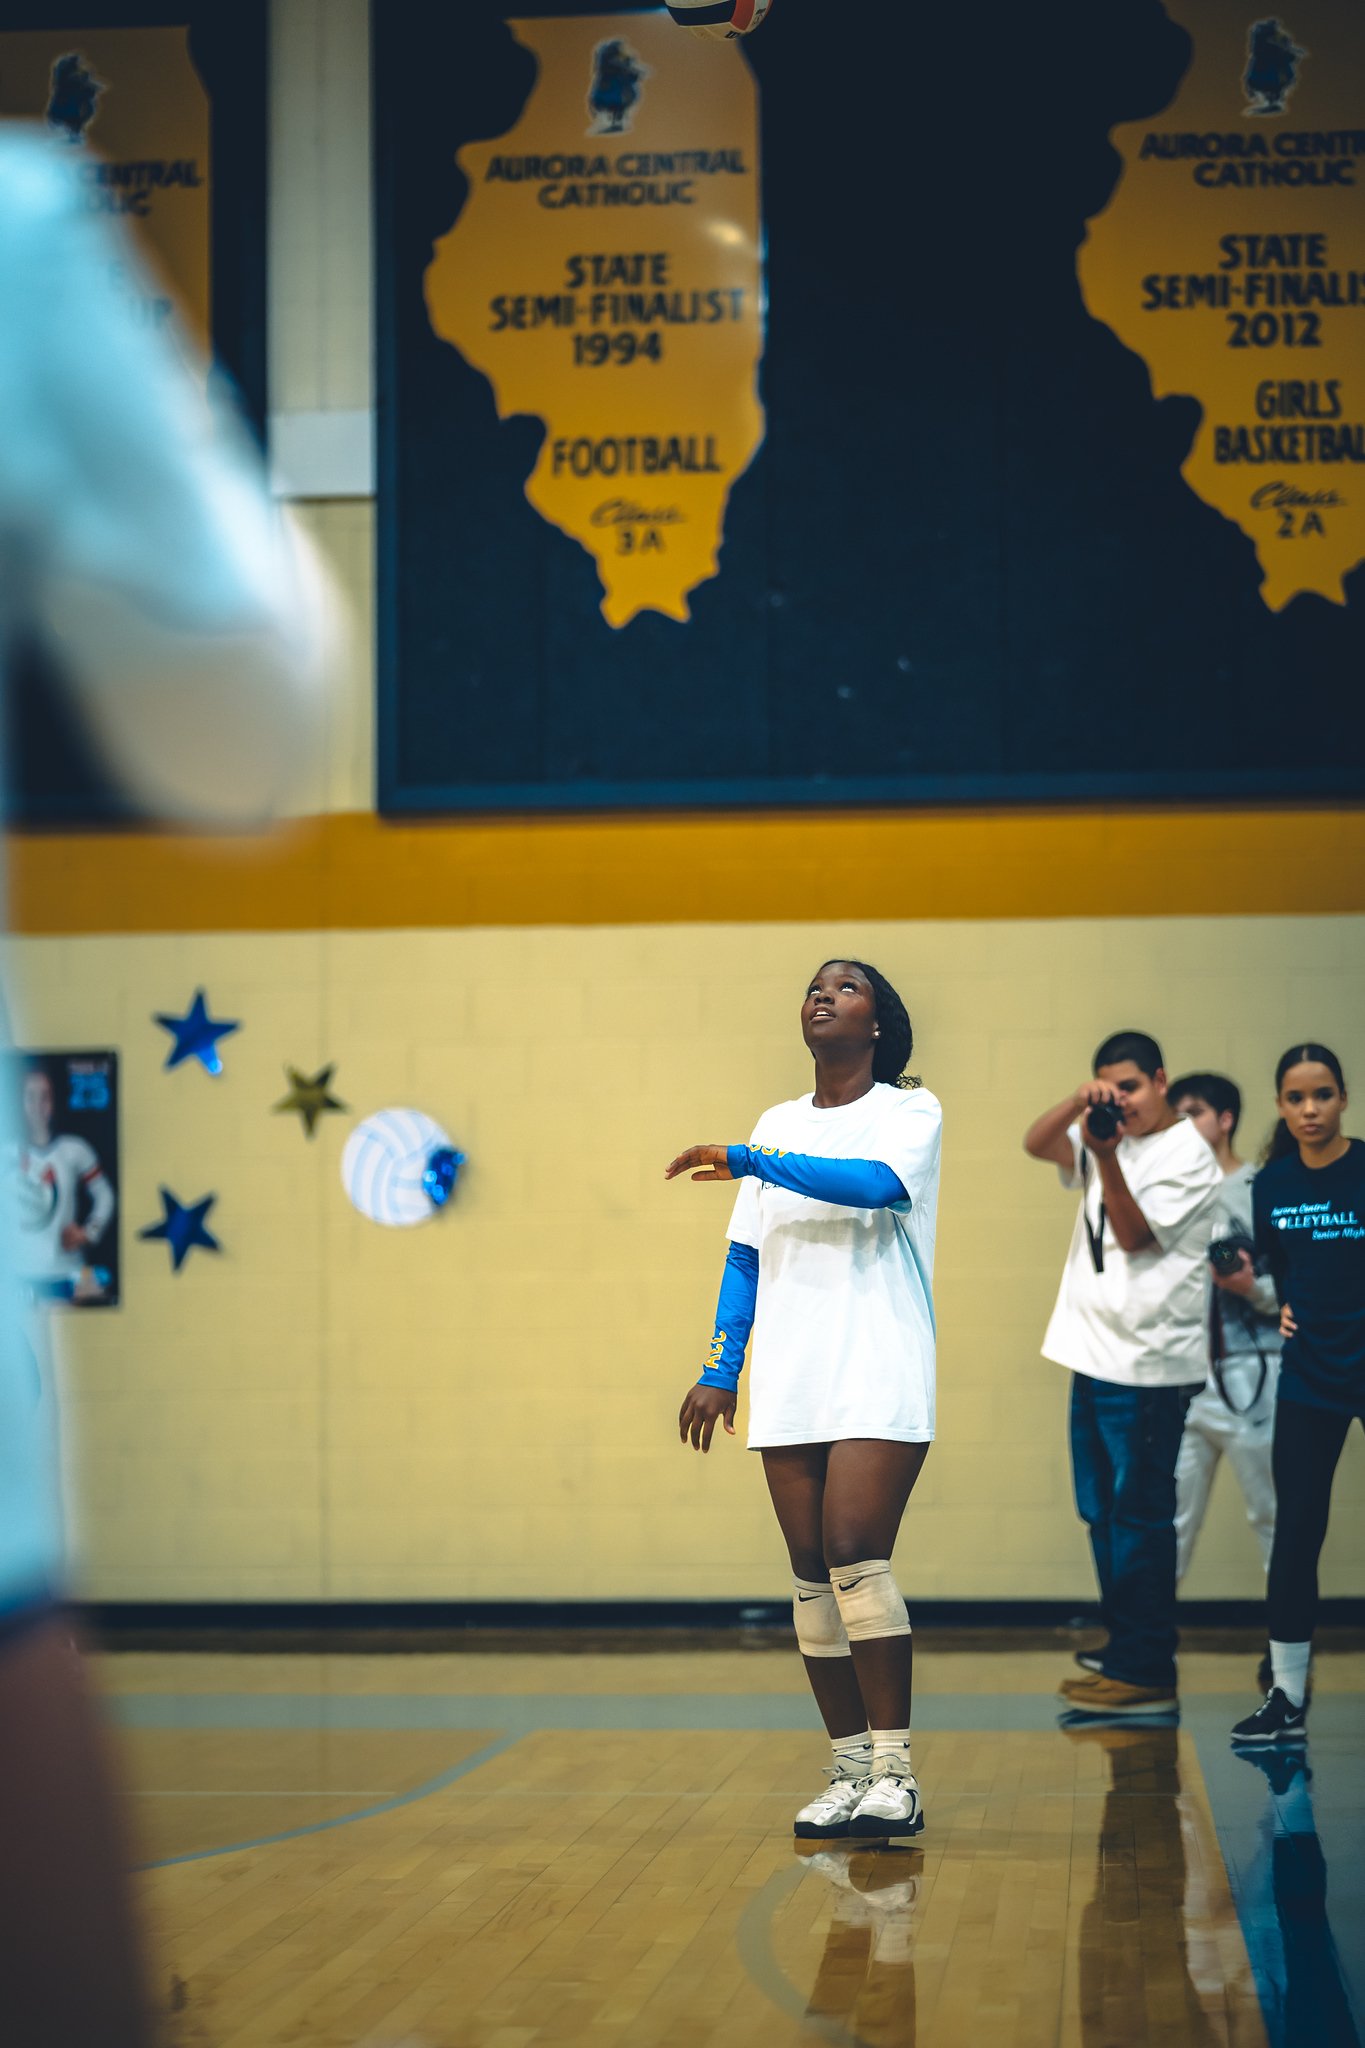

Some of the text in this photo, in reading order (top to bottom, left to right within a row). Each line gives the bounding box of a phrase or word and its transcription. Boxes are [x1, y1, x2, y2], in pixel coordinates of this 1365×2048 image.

[1139, 129, 1365, 160] AURORA CENTR
[485, 149, 746, 182] AURORA CENTRAL
[1193, 159, 1356, 188] CATHOLIC
[537, 180, 695, 209] CATHOLIC
[1219, 232, 1328, 270] STATE
[565, 252, 670, 288] STATE
[1141, 271, 1365, 311] SEMI-FINALI
[488, 288, 746, 331] SEMI-FINALIST
[1226, 311, 1323, 348] 2012
[572, 330, 662, 366] 1994
[1255, 379, 1343, 420] GIRLS
[552, 435, 723, 478] FOOTBALL
[1214, 423, 1365, 464] BASKETBAL
[1299, 1200, 1331, 1214] Central
[1312, 1226, 1365, 1241] Senior Nigh
